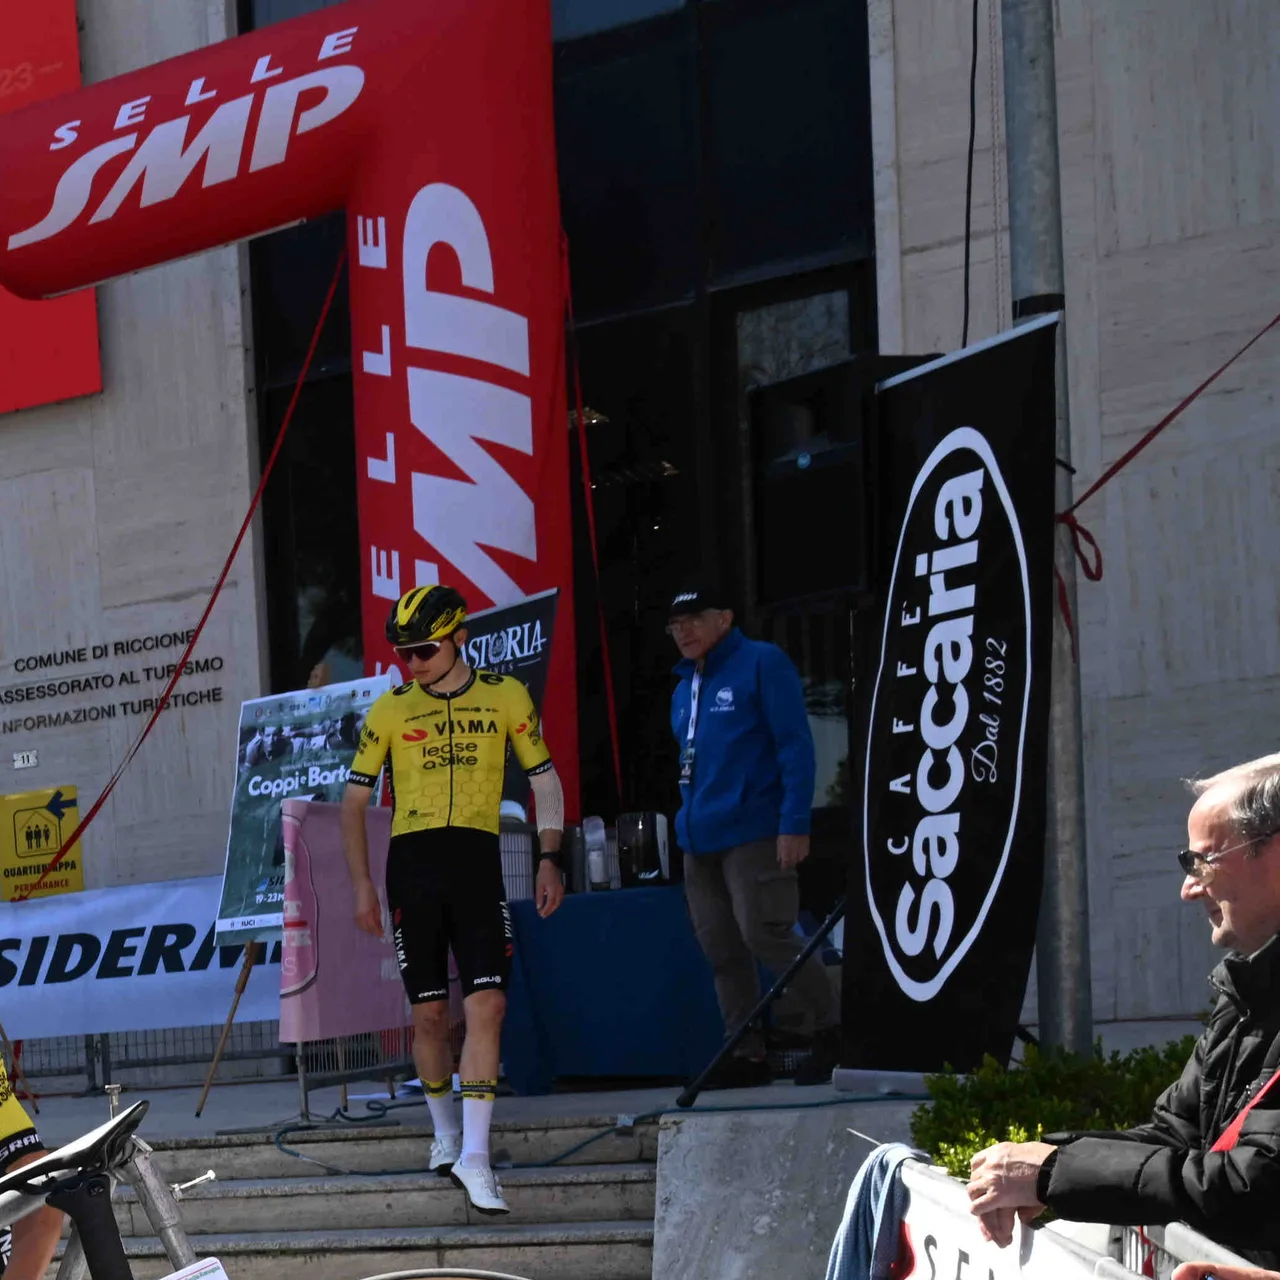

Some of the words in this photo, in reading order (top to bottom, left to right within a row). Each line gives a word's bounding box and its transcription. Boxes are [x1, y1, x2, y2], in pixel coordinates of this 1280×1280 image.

[49, 26, 358, 151] SELLE
[7, 64, 366, 251] SMP
[14, 648, 87, 673] COMUNE
[92, 645, 108, 659] DI
[114, 629, 197, 656] RICCIONE
[118, 669, 140, 685] AL
[982, 637, 1008, 709] 1882
[435, 719, 498, 736] VISMA
[896, 467, 985, 960] Saccaria
[20, 754, 31, 765] 11
[423, 741, 478, 757] lease
[970, 714, 1000, 783] Dal
[248, 770, 300, 798] Coppi
[394, 928, 408, 971] VISMA
[473, 976, 494, 985] AGU
